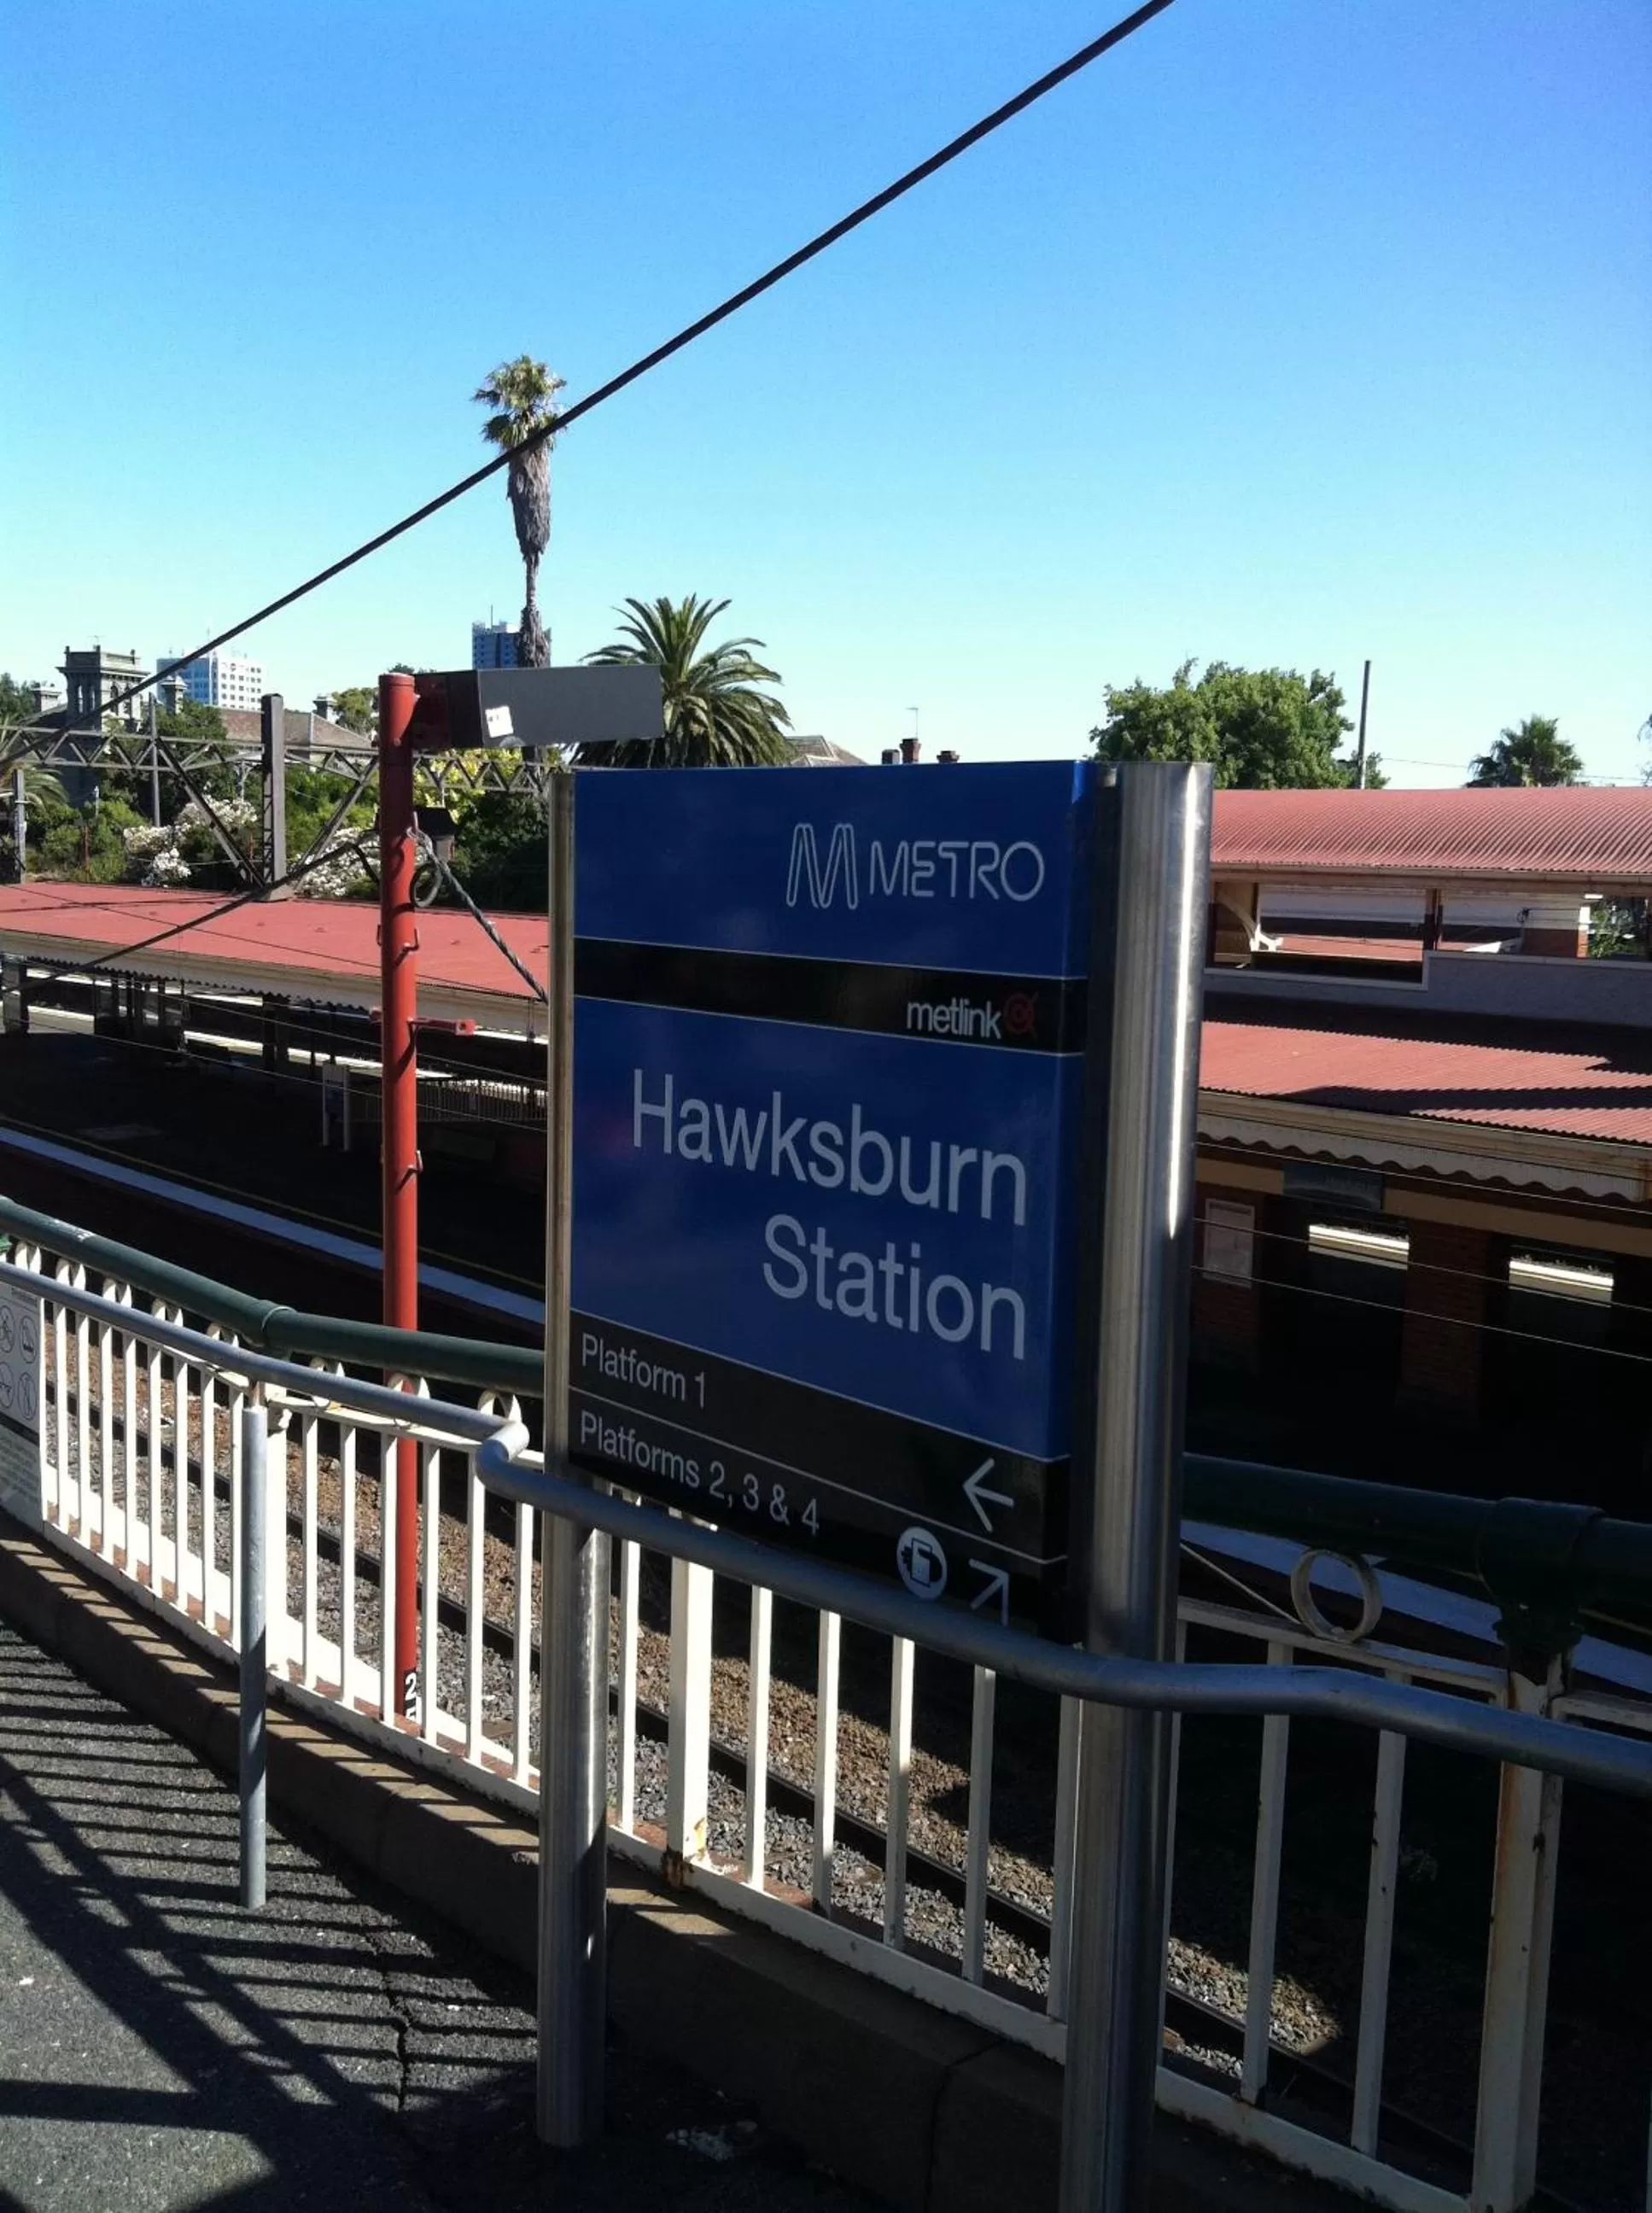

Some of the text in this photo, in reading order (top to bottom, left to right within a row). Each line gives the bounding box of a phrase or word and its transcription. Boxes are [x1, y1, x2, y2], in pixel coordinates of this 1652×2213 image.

[869, 840, 1045, 902] METRO
[907, 996, 1001, 1040] metlink
[633, 1068, 1025, 1225] Hawksburn
[763, 1213, 1025, 1361] Station
[581, 1332, 706, 1409] Platform 1
[581, 1410, 820, 1536] Platforms 2, 3 & 4
